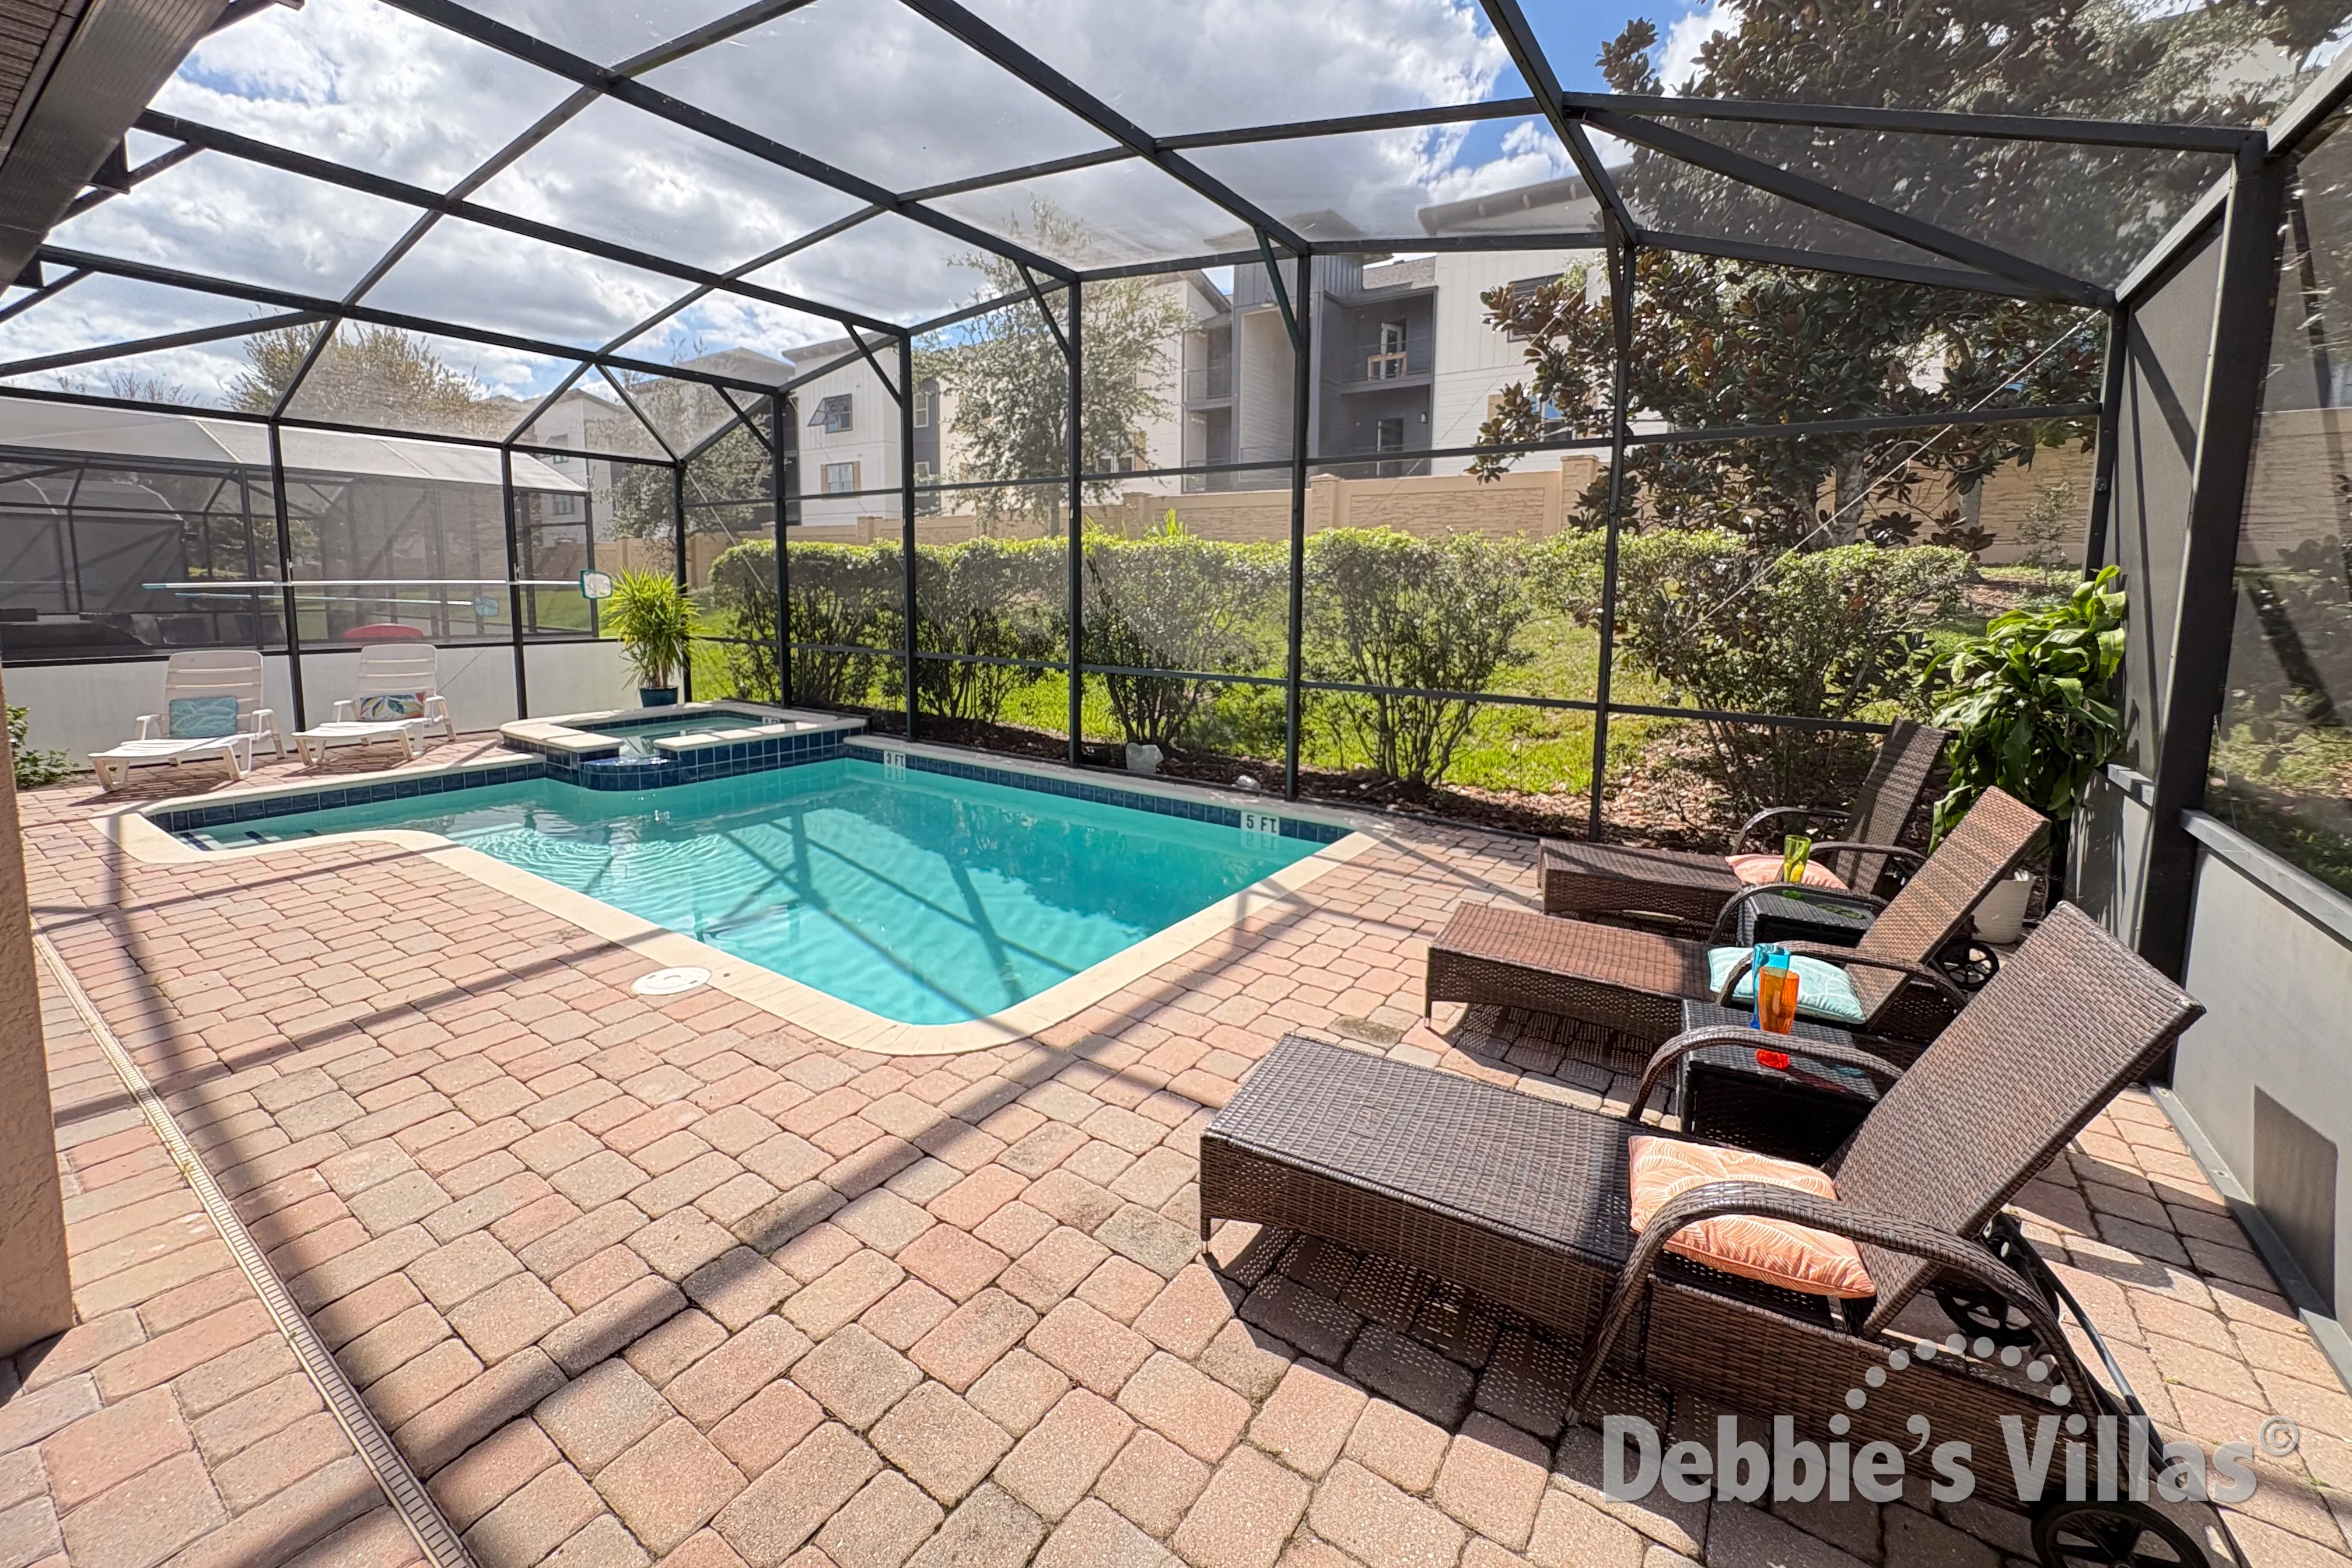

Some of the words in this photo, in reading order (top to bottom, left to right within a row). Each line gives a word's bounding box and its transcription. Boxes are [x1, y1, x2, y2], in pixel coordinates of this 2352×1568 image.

[887, 752, 892, 764] 3
[895, 754, 904, 767] FT
[1246, 814, 1254, 829] 5
[1261, 817, 1277, 833] FT
